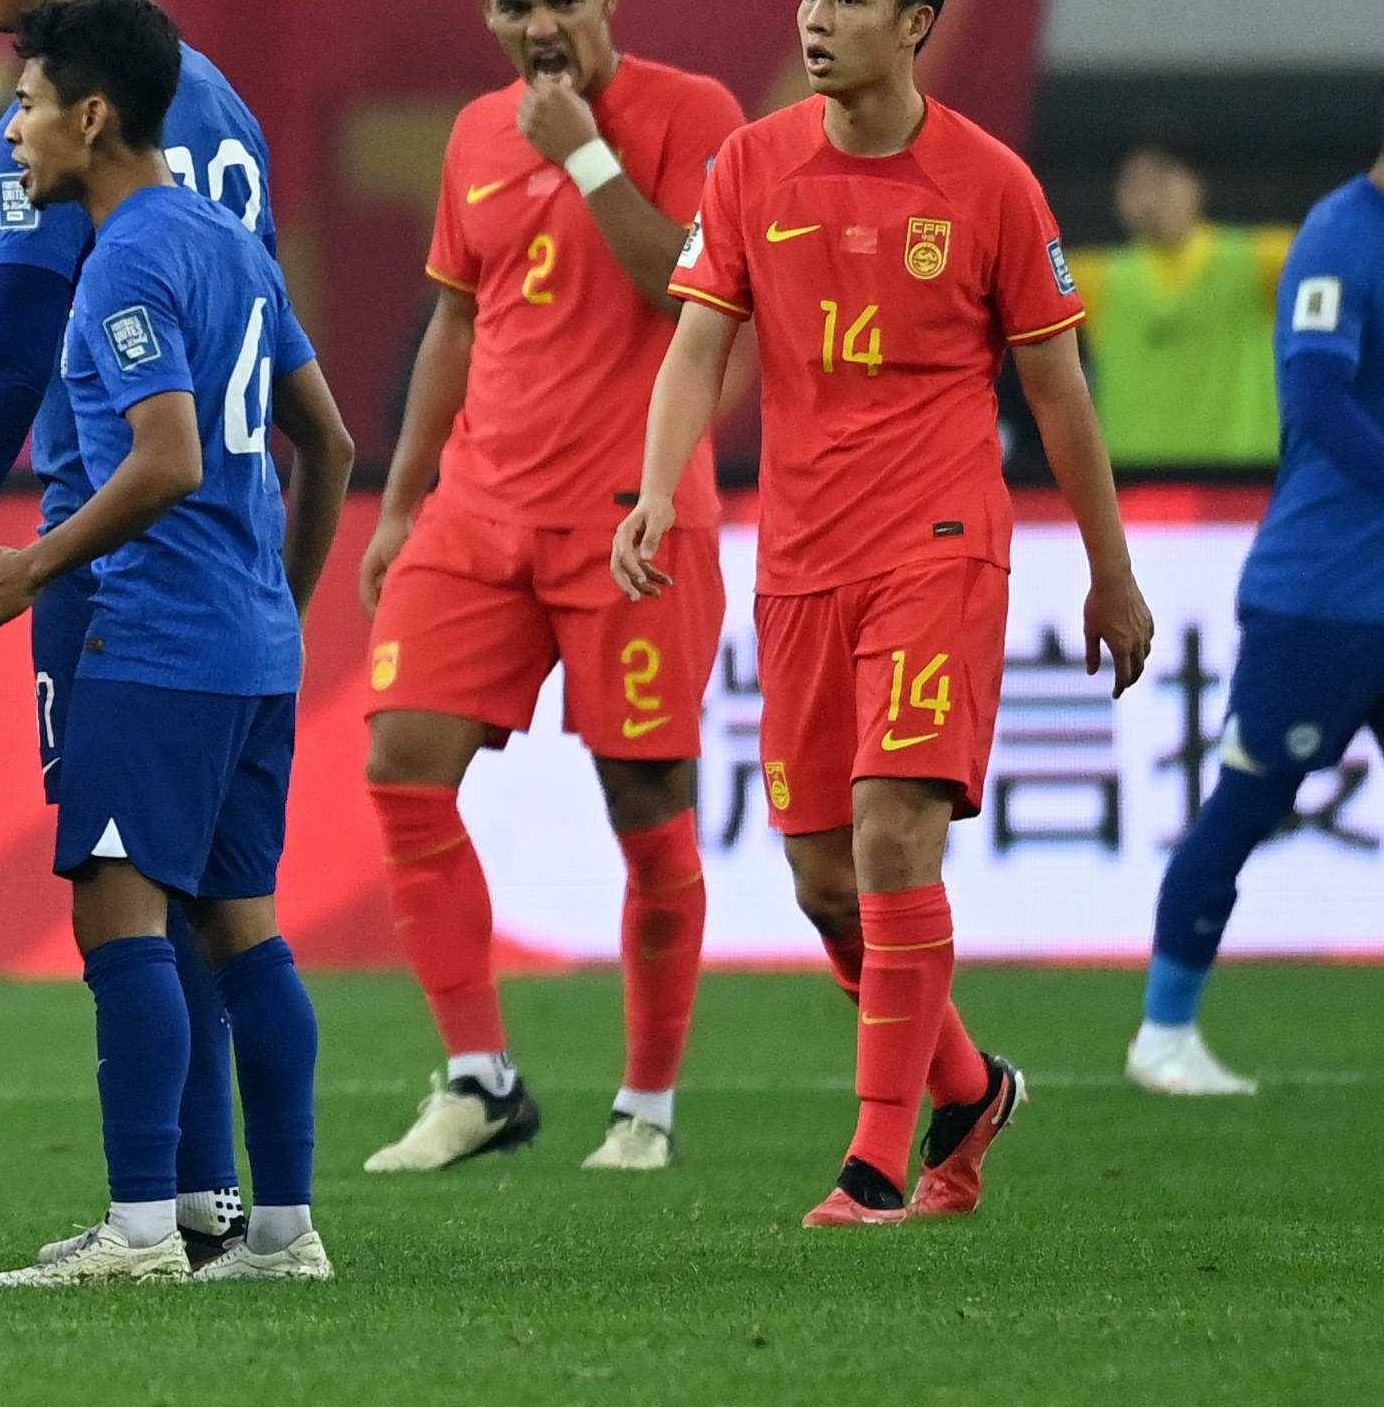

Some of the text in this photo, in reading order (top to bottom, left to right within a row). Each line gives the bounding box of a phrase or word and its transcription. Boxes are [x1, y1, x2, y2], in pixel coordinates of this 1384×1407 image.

[521, 233, 555, 305] 2
[820, 299, 883, 377] 14
[620, 639, 661, 710] 2
[887, 650, 951, 726] 14
